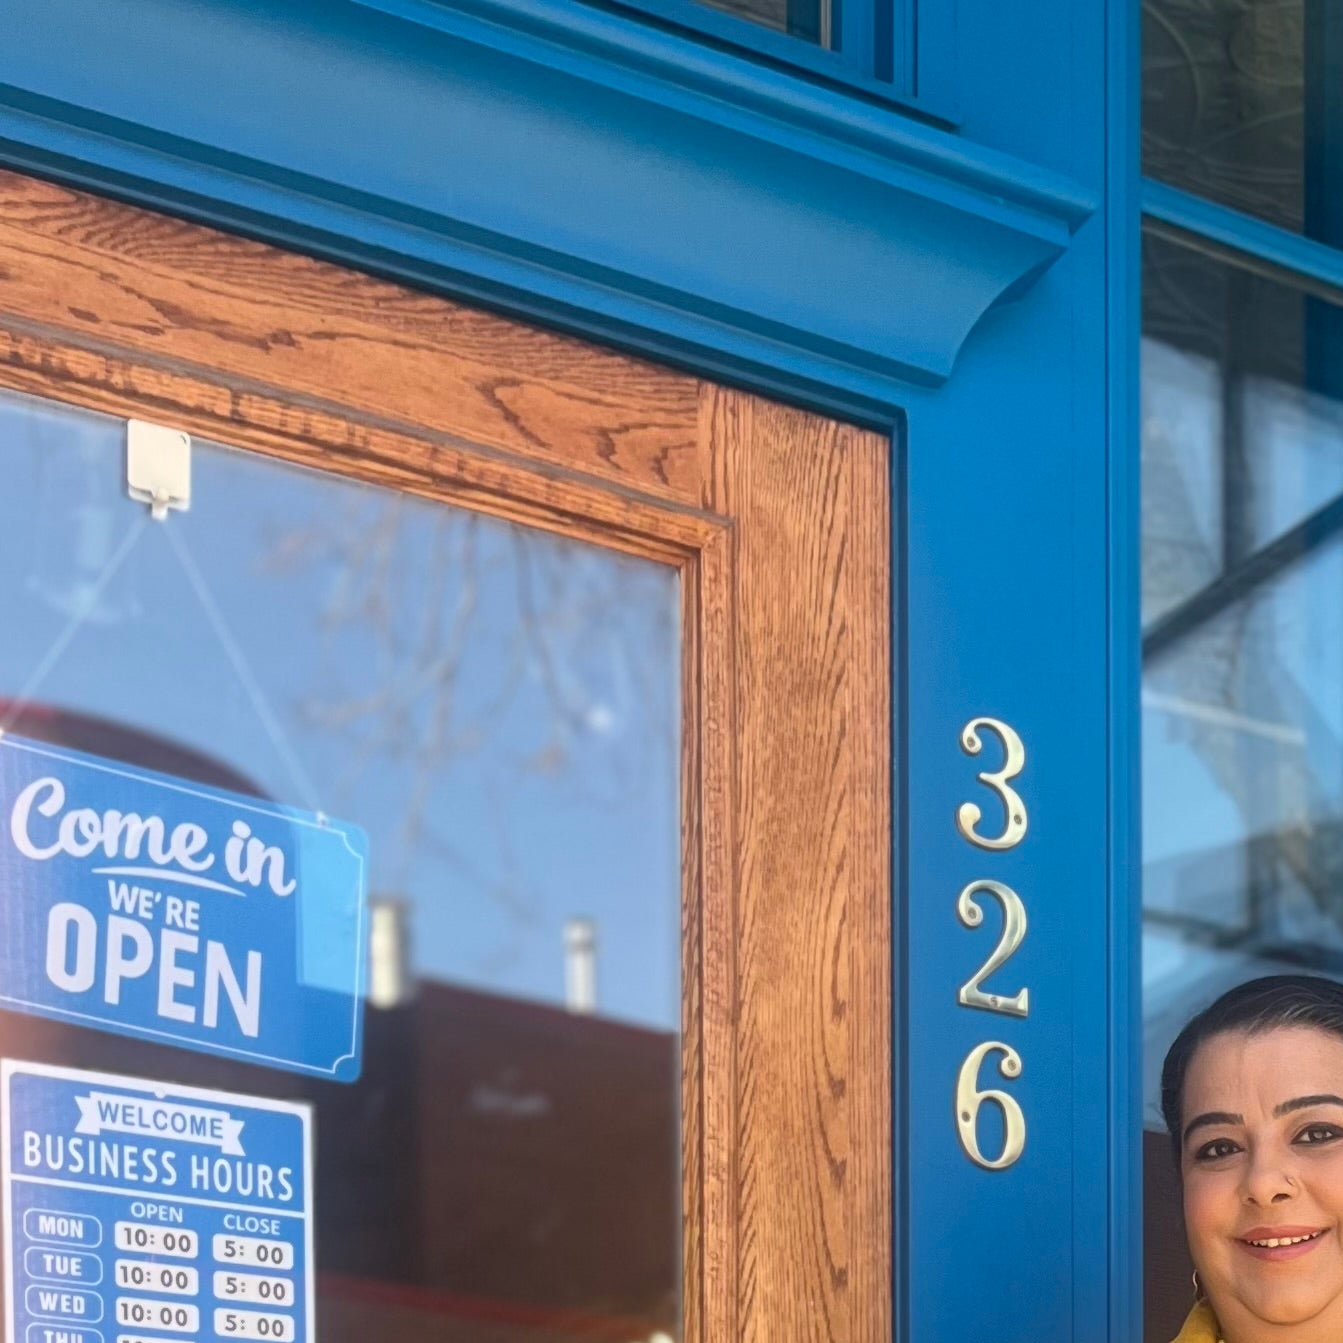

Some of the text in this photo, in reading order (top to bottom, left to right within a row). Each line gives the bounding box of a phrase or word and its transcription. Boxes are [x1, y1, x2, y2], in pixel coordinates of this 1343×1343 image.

[10, 777, 297, 897] Come in
[107, 879, 200, 931] WE'RE
[957, 716, 1029, 1170] 326
[45, 902, 262, 1038] OPEN
[98, 1100, 224, 1139] WELCOME
[23, 1131, 293, 1202] BUSINESS HOURS
[38, 1215, 84, 1239] MON
[130, 1202, 281, 1236] OPEN CLOSE
[43, 1254, 82, 1277] TUE
[39, 1291, 86, 1315] WED
